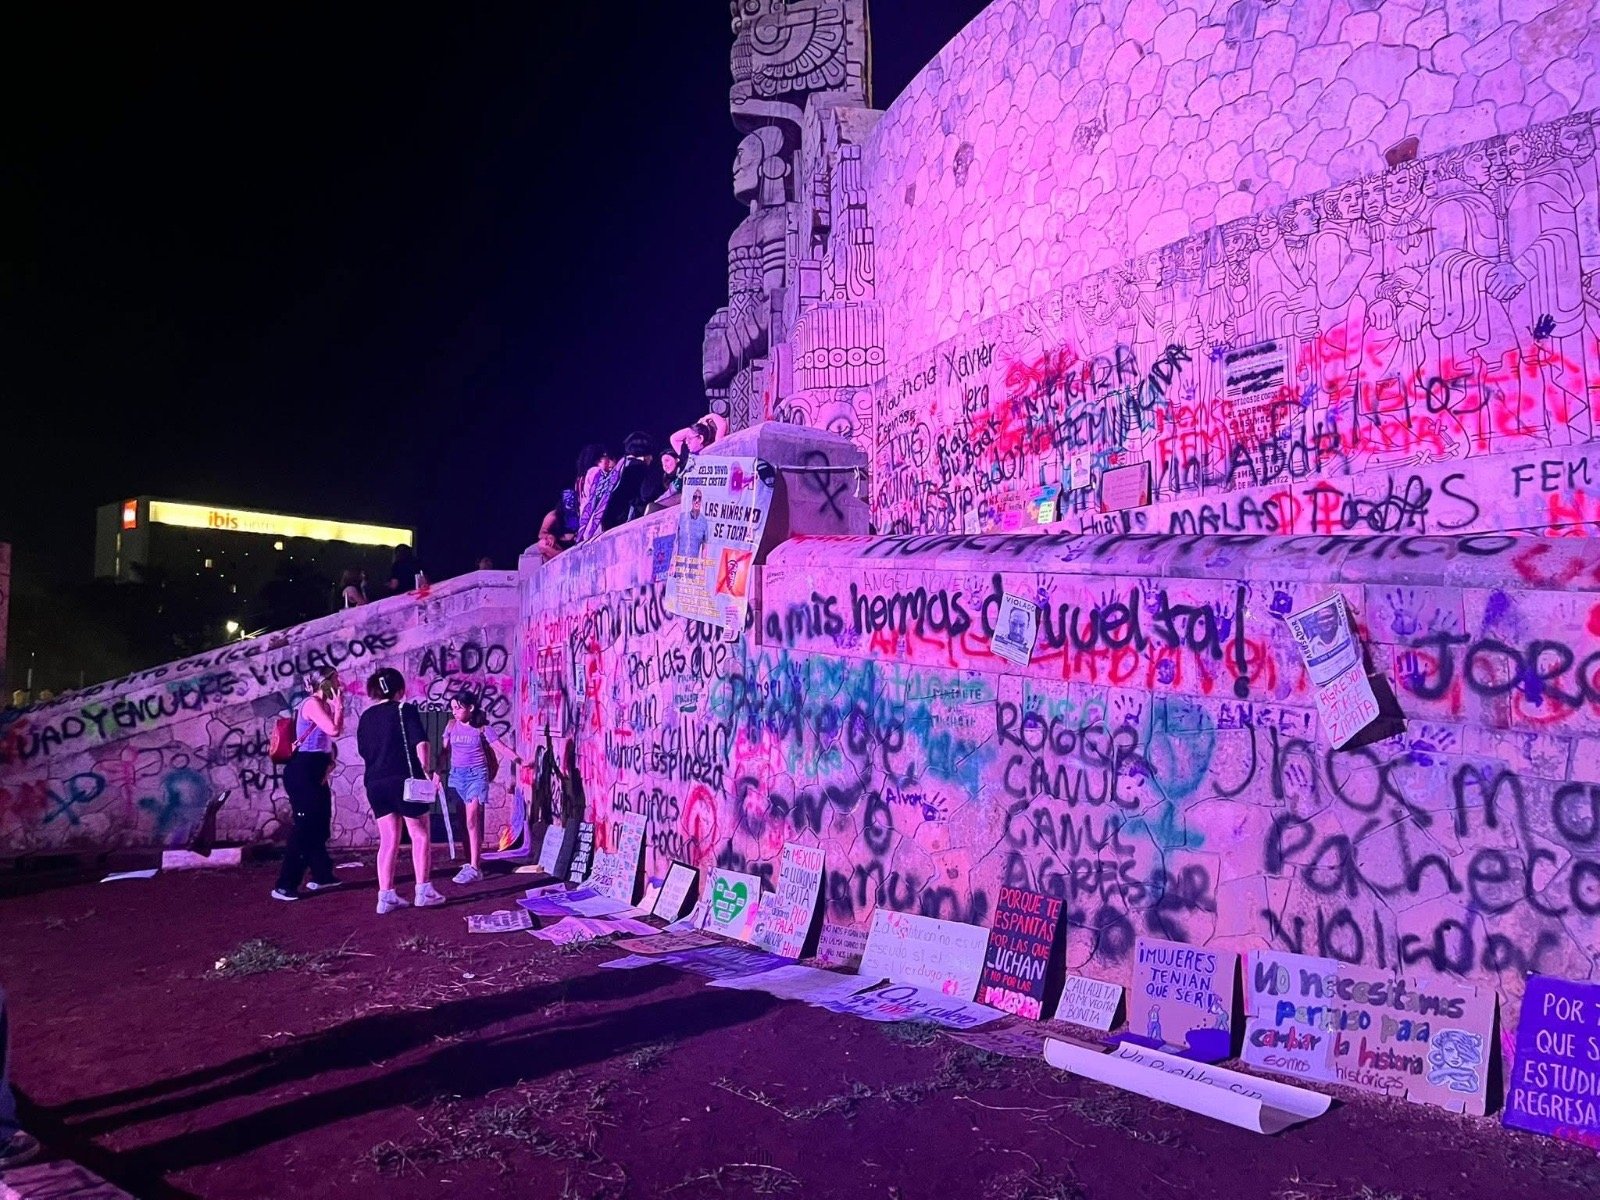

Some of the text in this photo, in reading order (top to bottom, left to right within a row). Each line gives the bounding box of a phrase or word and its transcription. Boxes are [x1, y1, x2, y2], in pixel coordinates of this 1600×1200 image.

[208, 511, 238, 529] ibis
[704, 502, 719, 517] LAS
[714, 523, 723, 538] SE
[420, 642, 508, 678] ALDO
[1319, 668, 1364, 705] AGRESOR
[1001, 887, 1063, 919] PORQUE TE
[995, 911, 1056, 942] ESPANTAS
[991, 932, 1050, 959] POR LAS QUE
[1017, 979, 1032, 992] LAS
[1146, 982, 1168, 999] QUE
[1150, 967, 1213, 991] TENIAN
[1067, 1006, 1101, 1023] BONITA
[1543, 992, 1585, 1024] POR
[1380, 1014, 1431, 1045] para
[1536, 1029, 1576, 1058] QUE
[1333, 1032, 1350, 1057] la
[1358, 1036, 1424, 1075] historia
[1524, 1059, 1600, 1096] ESTUDI
